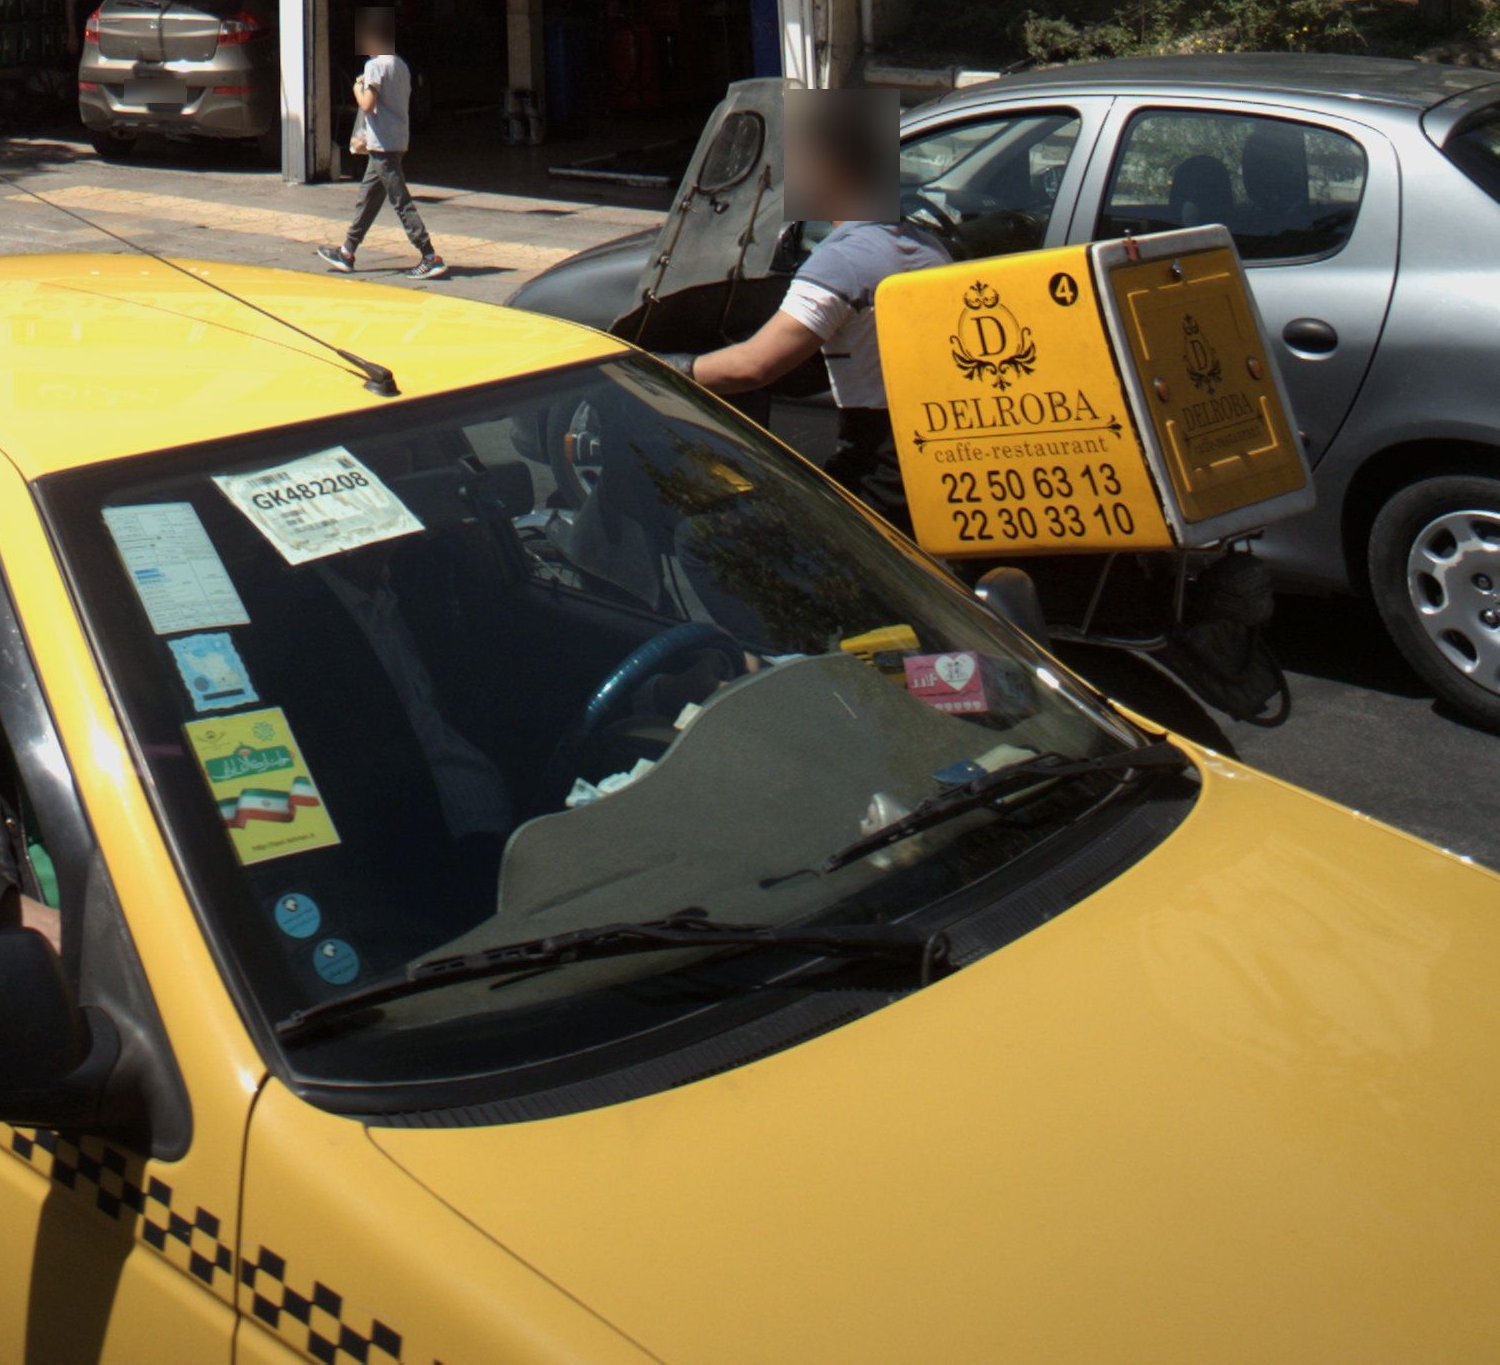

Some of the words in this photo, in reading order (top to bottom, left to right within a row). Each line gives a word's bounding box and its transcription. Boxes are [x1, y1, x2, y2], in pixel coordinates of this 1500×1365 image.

[1053, 276, 1075, 303] 4
[971, 315, 1007, 357] D
[922, 389, 1100, 433] DELROBA
[934, 436, 1109, 464] caffe-restaurant
[251, 471, 370, 511] GK482208
[942, 471, 982, 504] 22
[987, 468, 1026, 502] 50
[1032, 465, 1074, 500] 63
[1080, 462, 1122, 497] 13
[952, 509, 995, 541] 22
[997, 506, 1038, 540] 30
[1044, 504, 1086, 538] 33
[1093, 501, 1136, 536] 10
